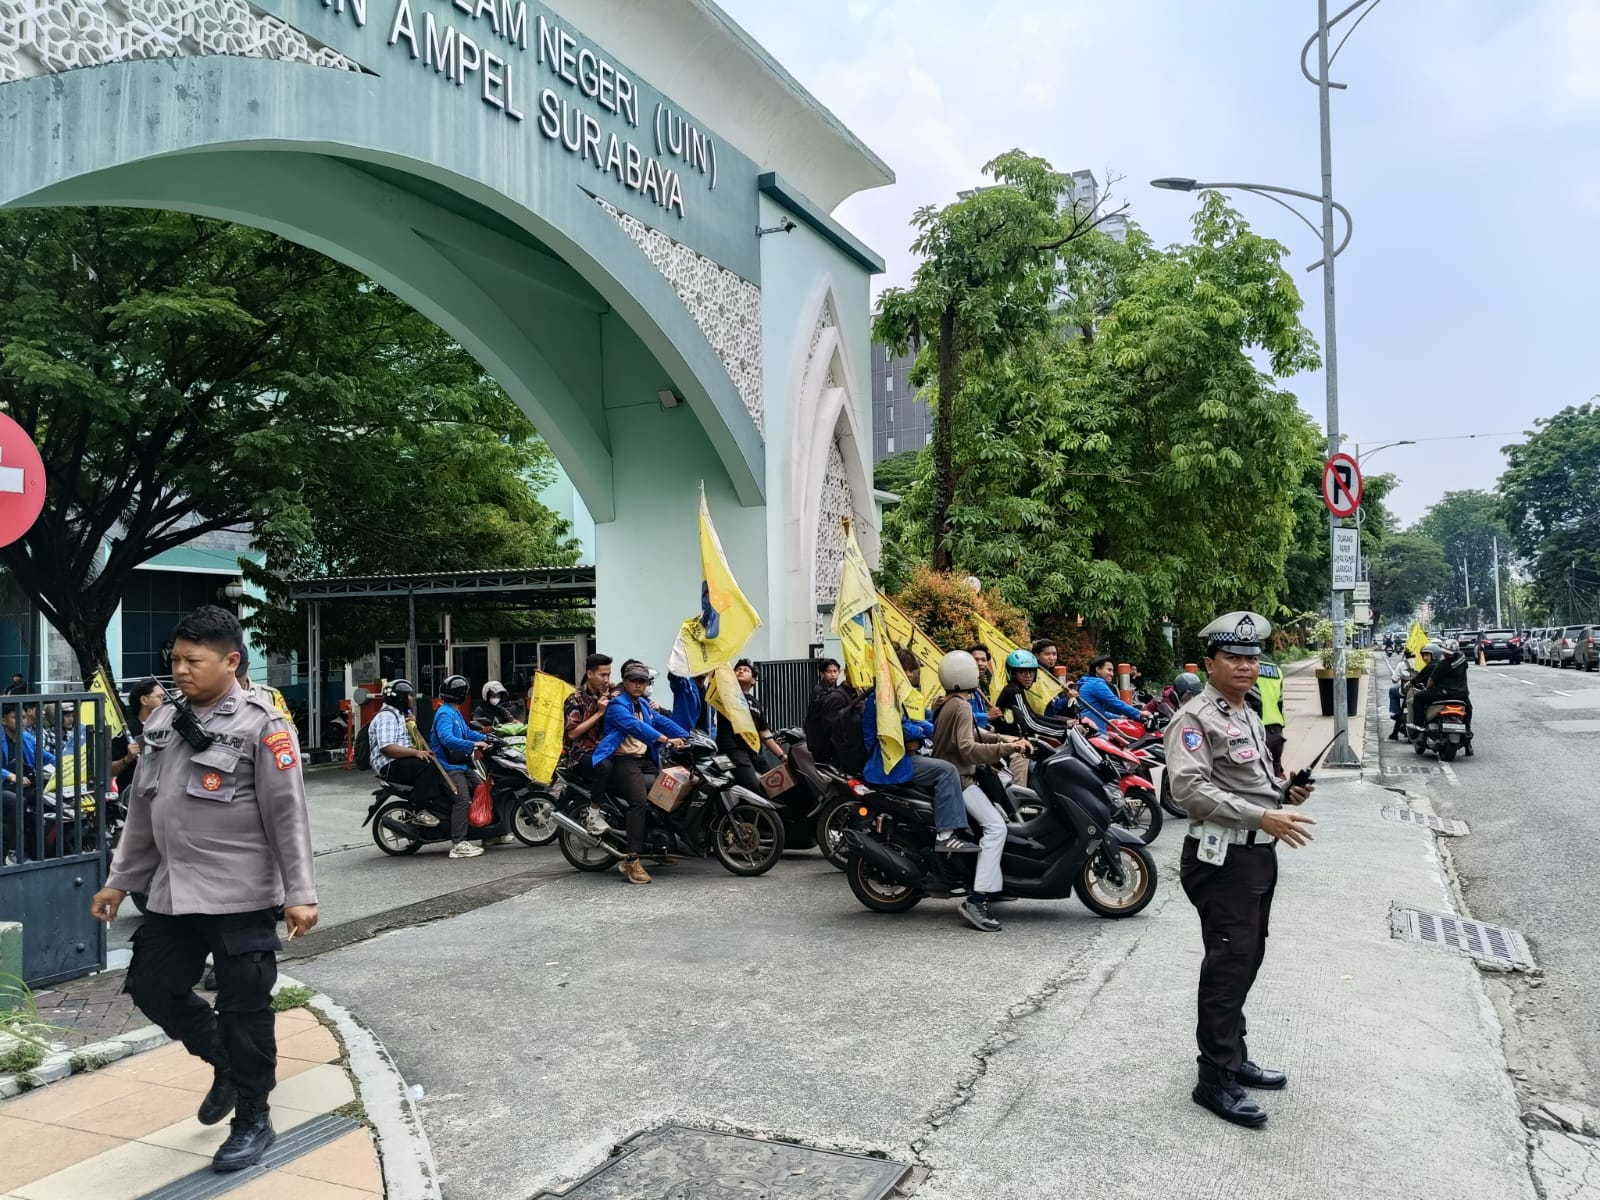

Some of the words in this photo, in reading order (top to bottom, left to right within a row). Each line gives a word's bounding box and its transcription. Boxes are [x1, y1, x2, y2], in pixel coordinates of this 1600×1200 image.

[387, 0, 524, 121] AMPEL
[538, 88, 685, 218] SURABAYA
[537, 15, 640, 127] NEGERI
[654, 102, 718, 190] (UIN)
